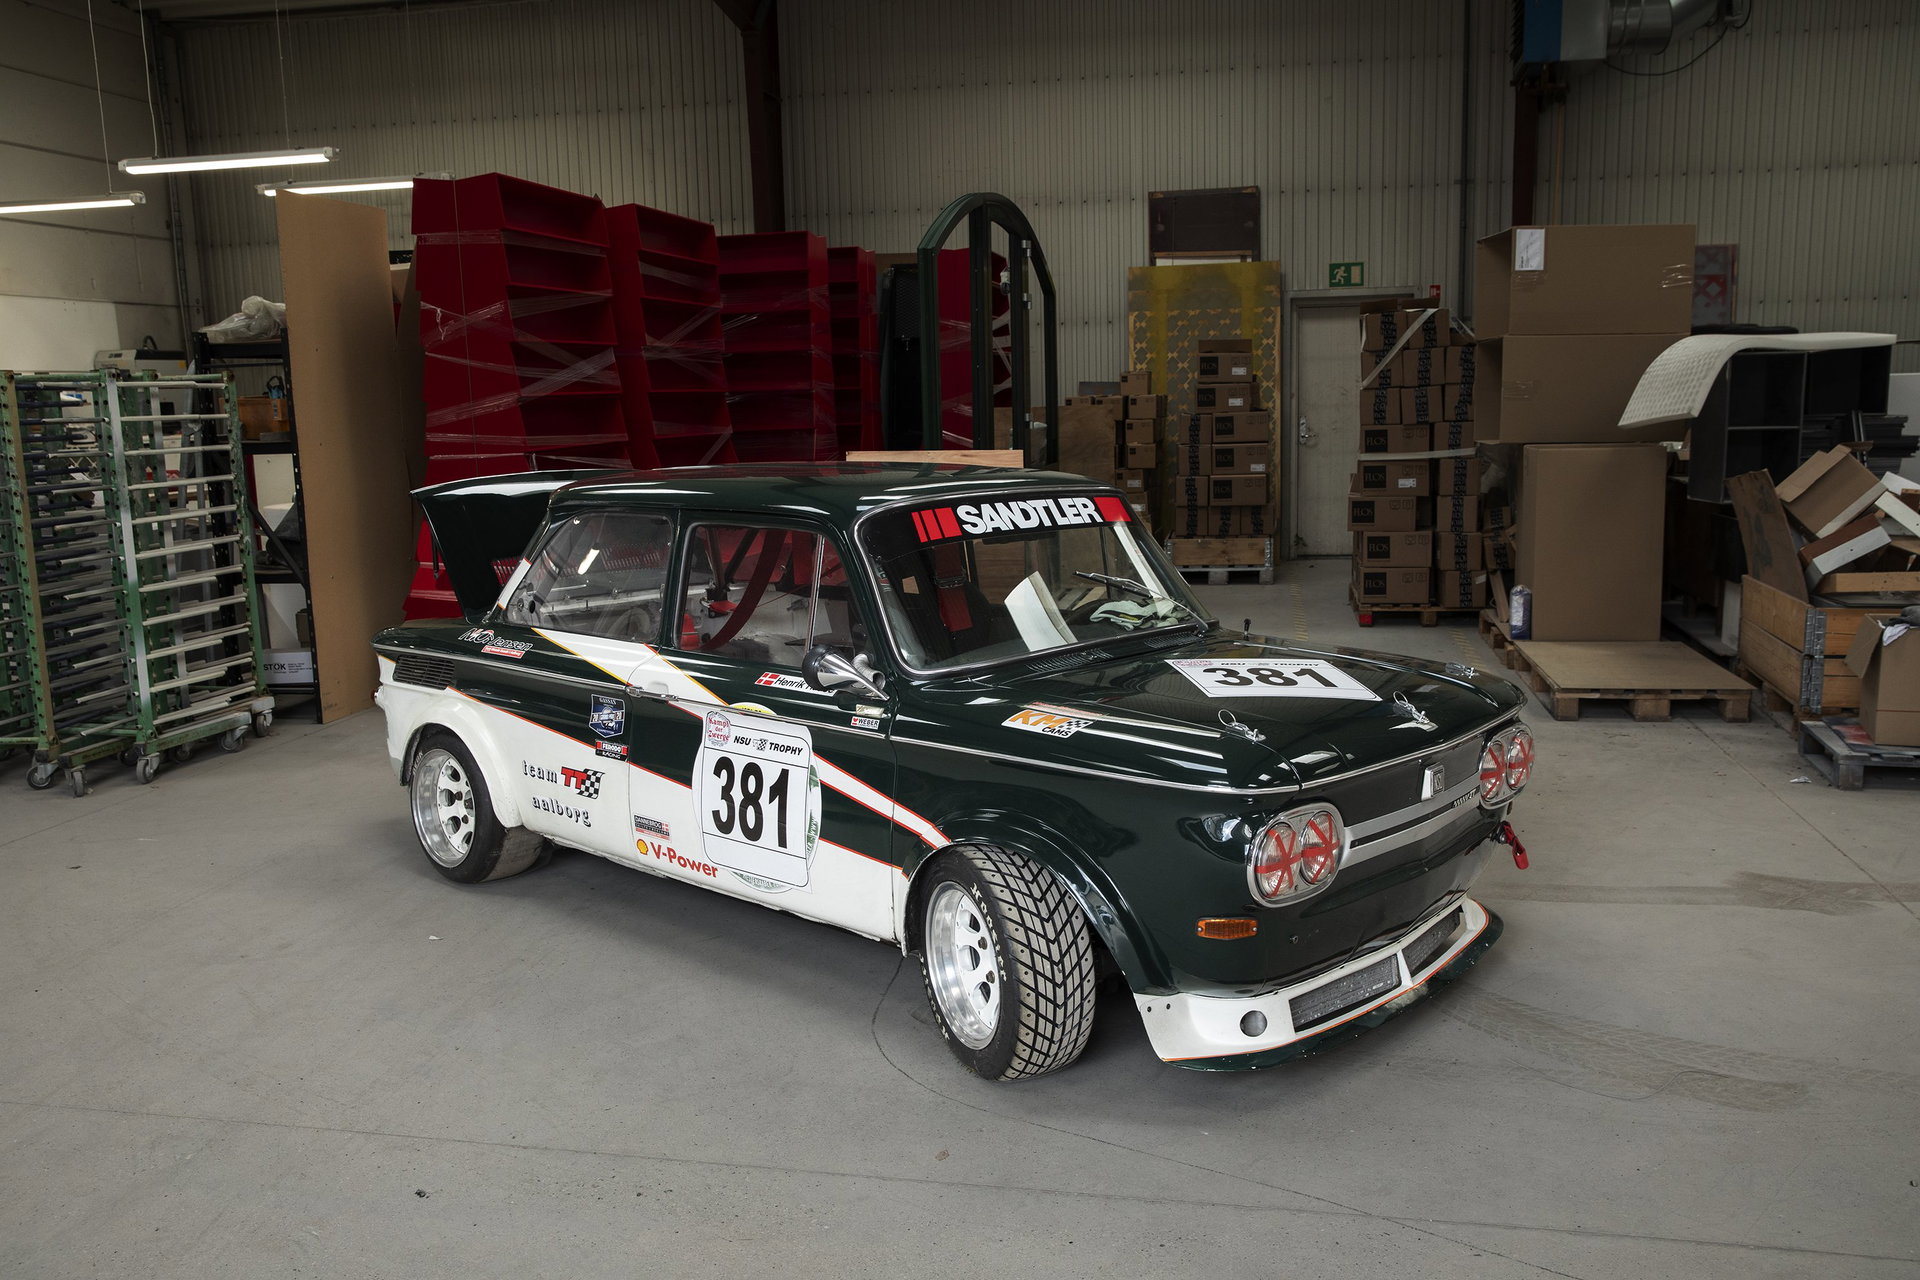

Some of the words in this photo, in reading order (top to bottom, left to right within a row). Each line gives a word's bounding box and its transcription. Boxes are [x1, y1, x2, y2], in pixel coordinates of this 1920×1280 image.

[1366, 437, 1386, 446] FLOS
[1364, 472, 1385, 482] FLOS
[956, 497, 1104, 535] SANDTLER
[1353, 507, 1374, 517] FLOS
[1368, 543, 1389, 553] FLOS
[1365, 579, 1385, 589] FLOS
[774, 677, 806, 689] Henrik
[1203, 667, 1338, 688] 381
[857, 718, 879, 726] WEBER
[1009, 710, 1070, 729] KM
[1041, 726, 1072, 737] CAMS
[602, 743, 622, 753] FERODO
[733, 735, 752, 746] NSU
[769, 742, 803, 756] TROPHY
[602, 751, 621, 760] RACING
[521, 759, 558, 784] team
[711, 756, 790, 849] 381
[532, 795, 592, 828] aalborg
[650, 841, 719, 878] V-Power
